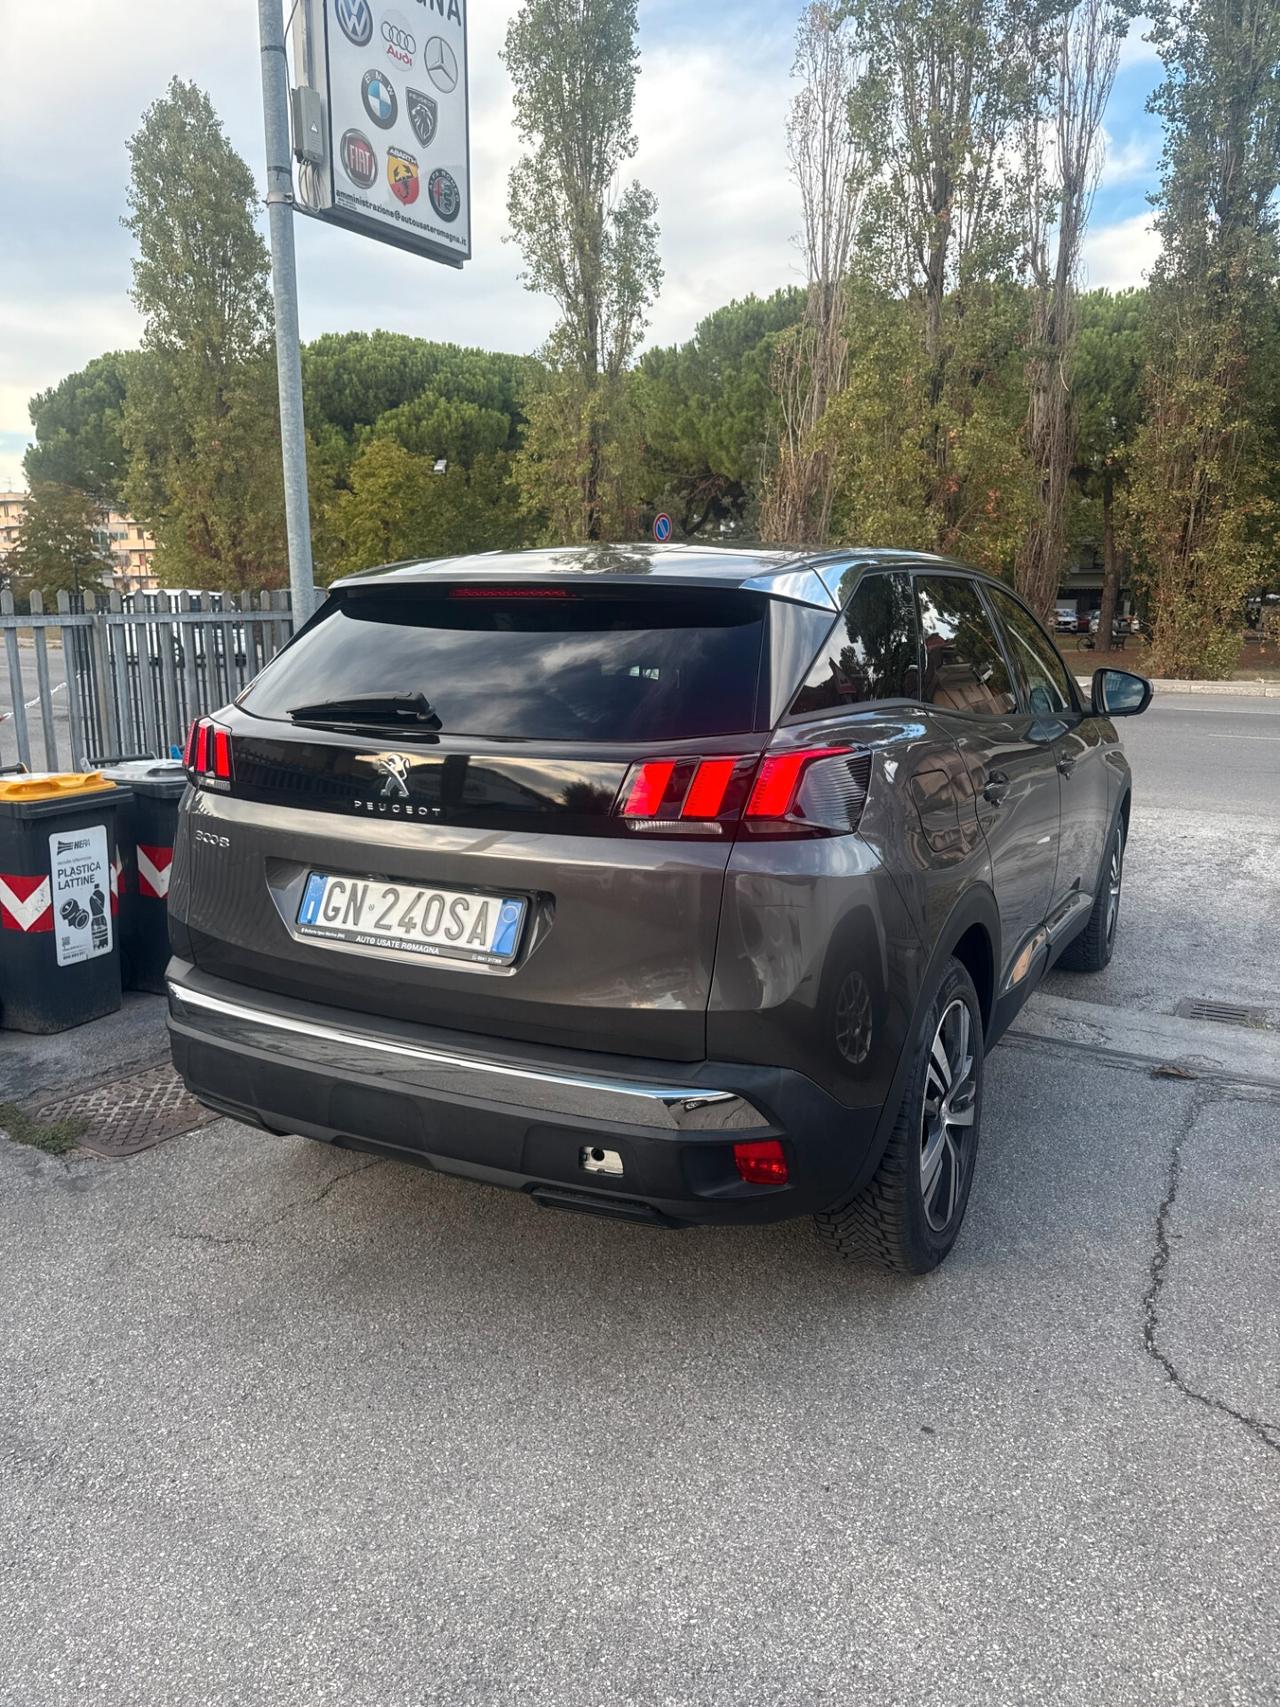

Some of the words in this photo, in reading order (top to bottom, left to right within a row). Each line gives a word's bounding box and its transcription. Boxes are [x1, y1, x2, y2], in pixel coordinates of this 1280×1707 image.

[364, 71, 395, 96] BMW
[349, 144, 370, 176] FIAT
[353, 800, 441, 817] PEUGEOT
[195, 829, 230, 848] 3008
[57, 861, 102, 879] PLASTICA
[57, 874, 95, 891] LATTINE
[322, 880, 369, 926] GN
[373, 887, 490, 947] 240SA
[355, 935, 376, 945] AUTO
[376, 938, 401, 949] USATE
[400, 941, 440, 955] ROMAGNA
